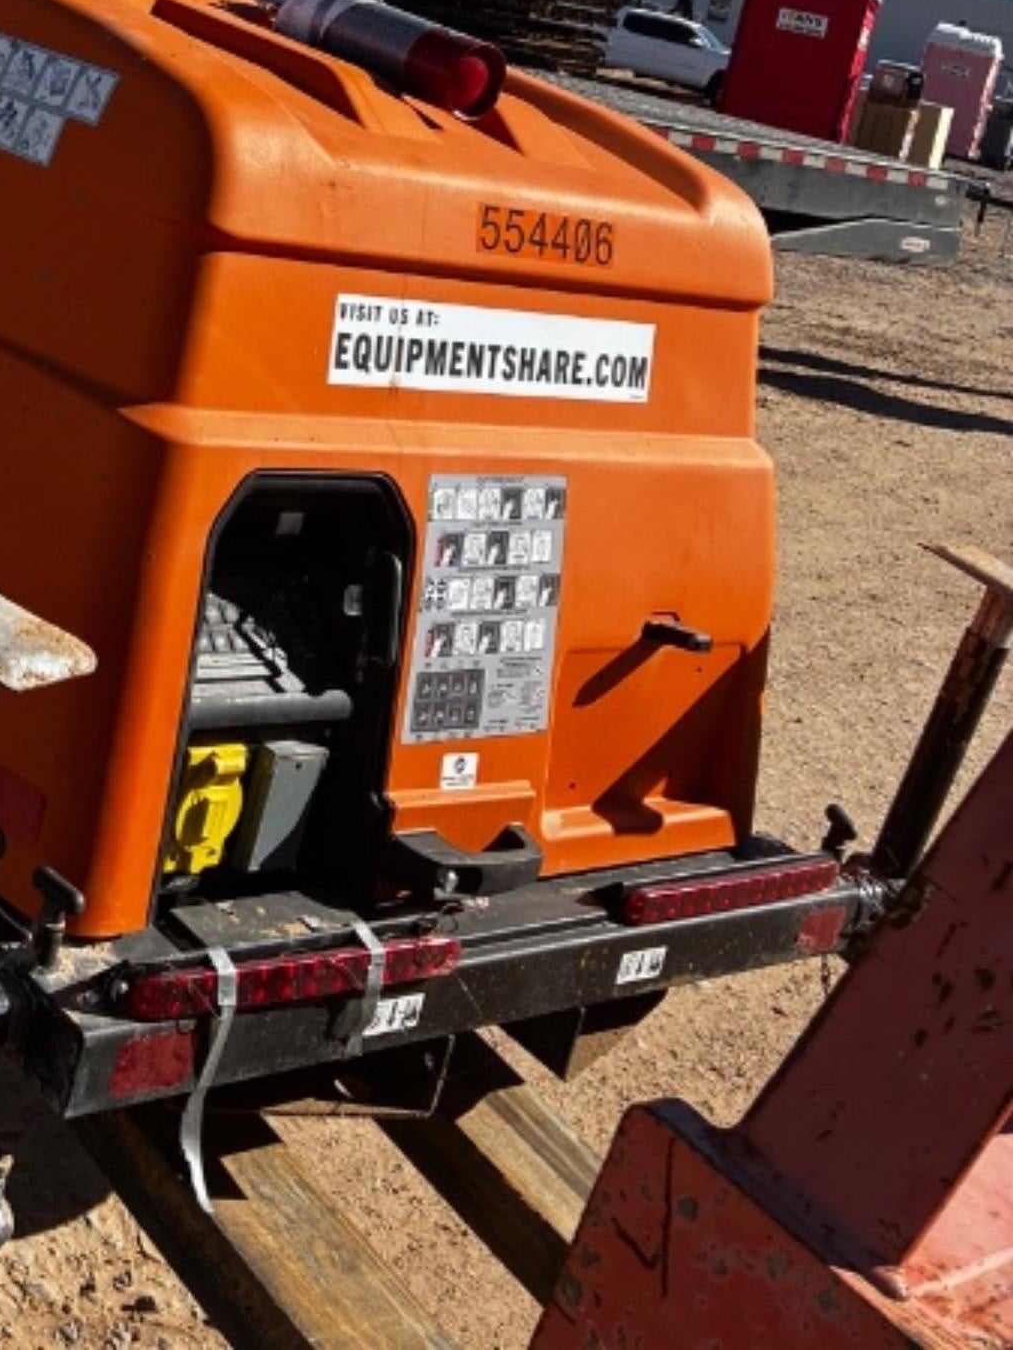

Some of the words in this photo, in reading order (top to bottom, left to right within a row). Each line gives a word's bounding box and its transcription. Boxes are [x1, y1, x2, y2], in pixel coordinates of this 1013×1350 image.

[480, 205, 614, 265] 554406
[339, 302, 382, 322] VISIT
[388, 307, 409, 325] US
[415, 308, 441, 328] AT:
[334, 332, 648, 389] EQUIPMENTSHARE.COM
